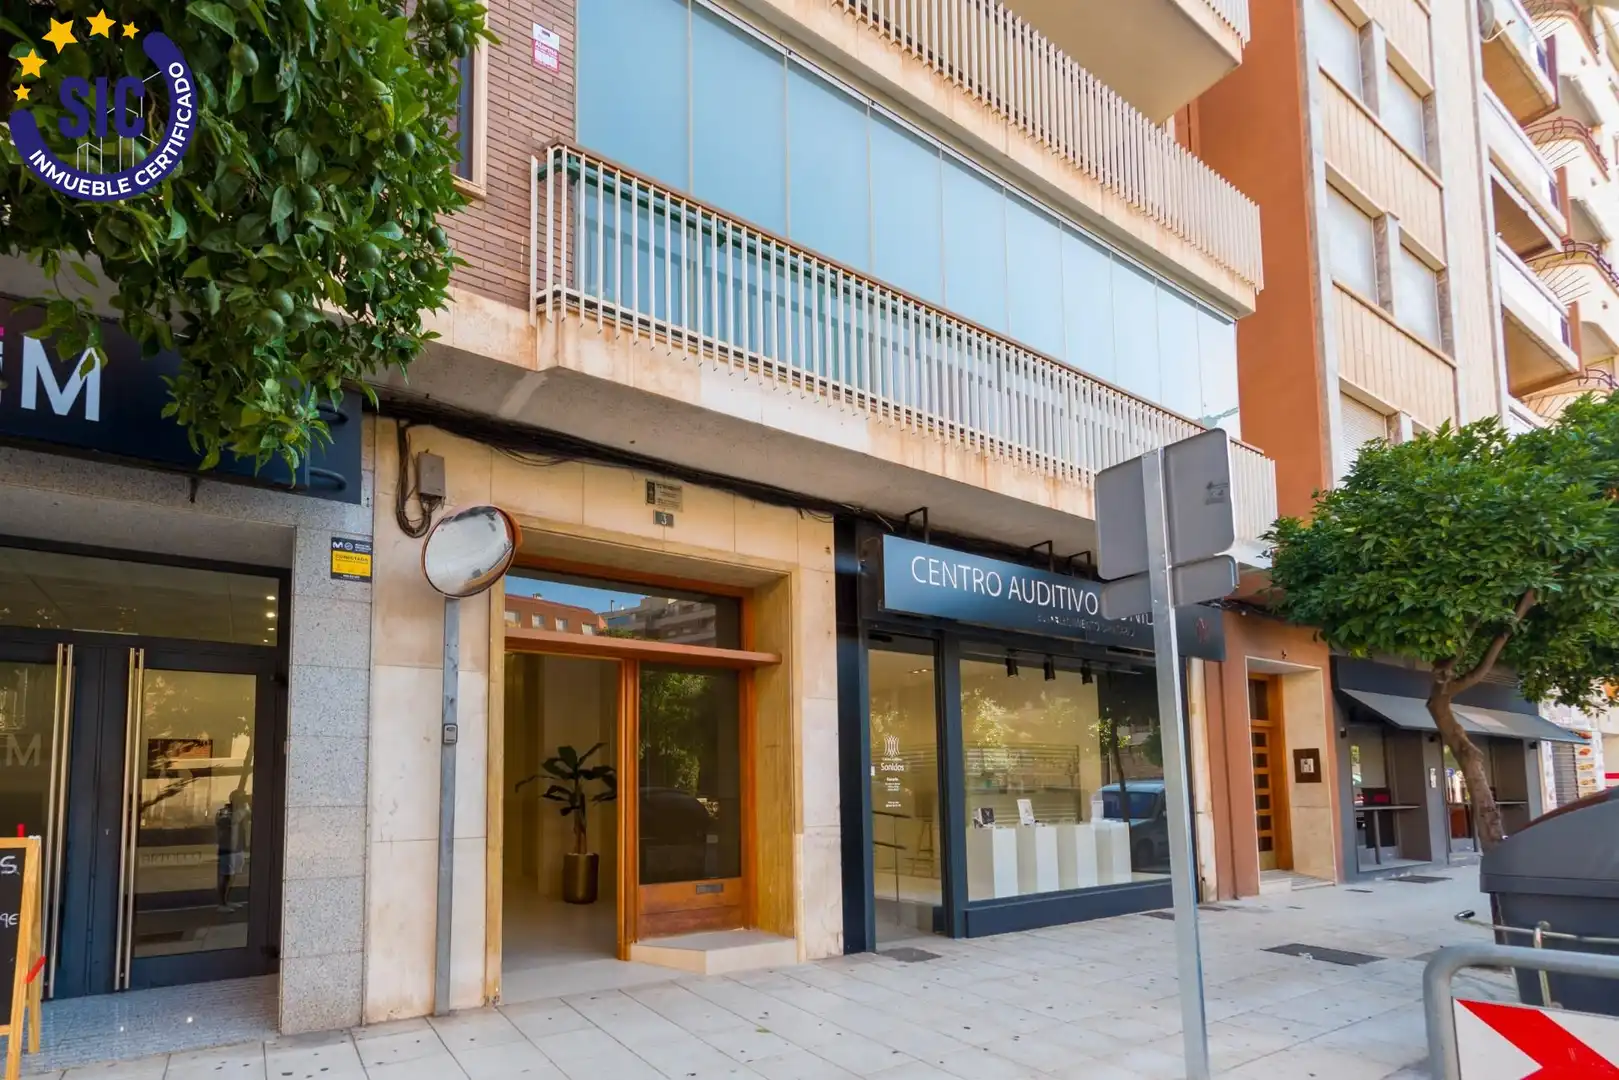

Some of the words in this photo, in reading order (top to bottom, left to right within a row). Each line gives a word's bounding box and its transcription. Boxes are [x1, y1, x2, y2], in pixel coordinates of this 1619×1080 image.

[0, 335, 100, 422] M
[911, 555, 1001, 597] CENTRO
[1008, 575, 1099, 616] AUDITIVO
[880, 762, 904, 772] Sonidos
